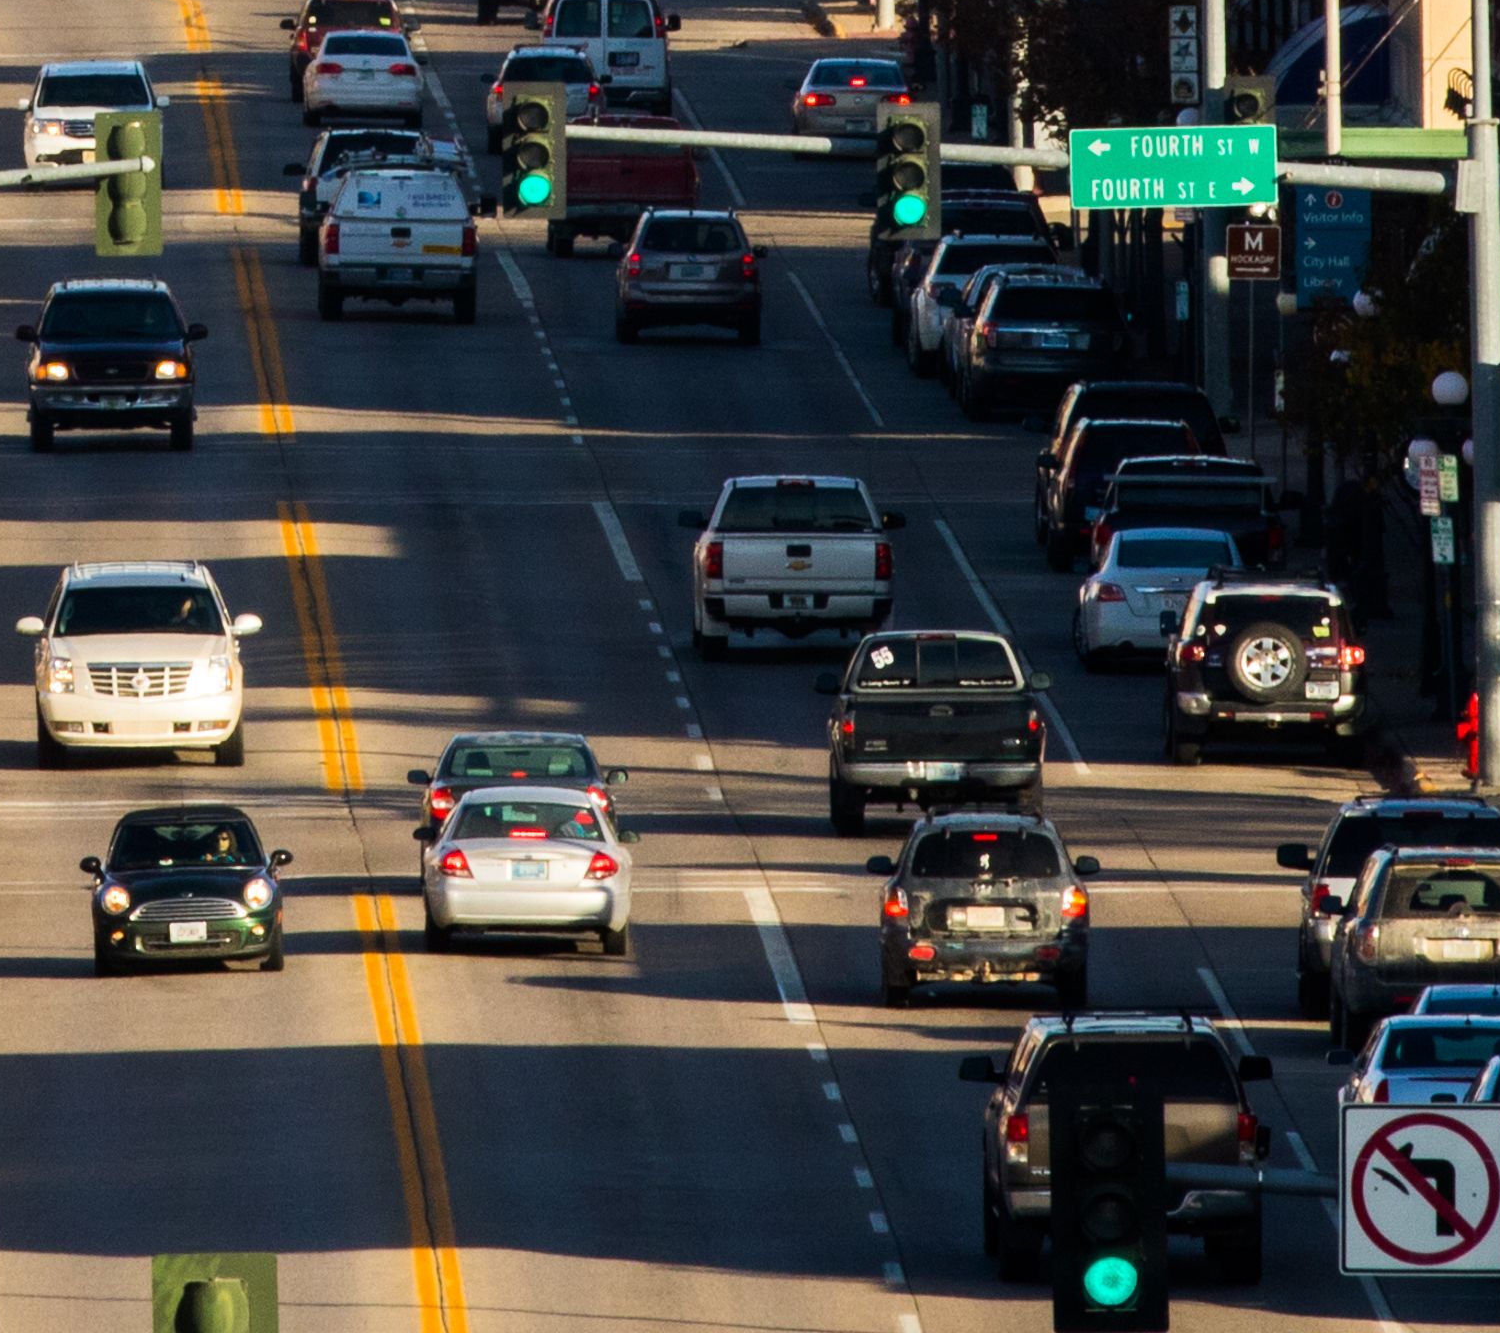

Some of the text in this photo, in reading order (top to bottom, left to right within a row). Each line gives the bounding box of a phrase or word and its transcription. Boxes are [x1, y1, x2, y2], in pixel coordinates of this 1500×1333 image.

[1130, 134, 1261, 158] FOURTH ST W
[1091, 178, 1217, 202] FOURTH ST E
[1302, 212, 1364, 224] Visitor Info
[1243, 231, 1264, 252] M
[1302, 256, 1350, 269] City Hall
[870, 645, 895, 670] 55
